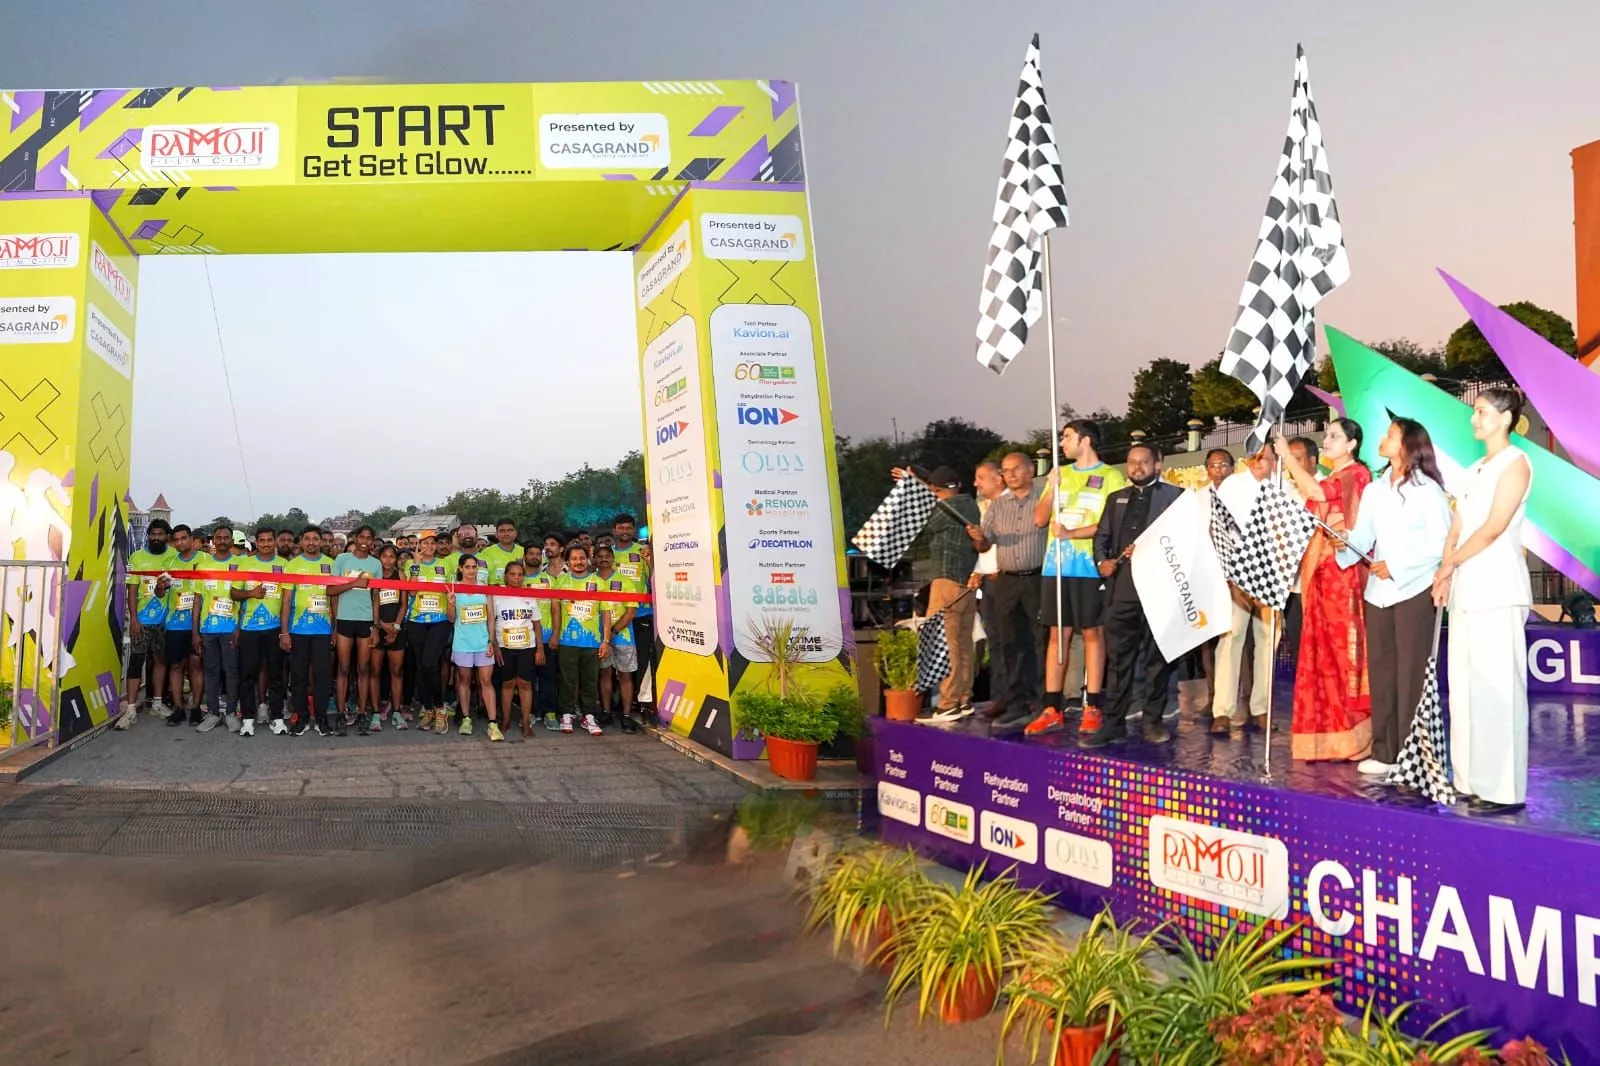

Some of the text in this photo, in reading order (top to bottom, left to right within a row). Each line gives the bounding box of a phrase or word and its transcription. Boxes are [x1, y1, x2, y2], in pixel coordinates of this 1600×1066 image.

[327, 104, 505, 148] START
[549, 122, 635, 133] Presented by
[151, 128, 263, 156] RAMOJI
[549, 142, 649, 154] CASAGRAND
[303, 154, 352, 178] Get
[359, 153, 408, 177] Set
[709, 220, 777, 232] Presented by
[710, 238, 789, 249] CASAGRAND
[641, 252, 682, 298] CASAGRAND
[37, 304, 50, 315] by
[733, 327, 789, 338] Kavion.ai
[90, 330, 126, 365] CASAGRAND
[737, 407, 779, 425] ION
[656, 421, 678, 446] ION
[765, 499, 809, 508] RENOVA
[761, 539, 813, 549] DECATHLON
[1160, 535, 1198, 622] CASAGRAND
[676, 627, 705, 639] ANYTIME
[676, 634, 705, 646] FITNESS
[889, 749, 904, 763] Tech
[885, 763, 908, 779] Partner
[931, 760, 964, 779] Associate
[935, 776, 960, 793] Partner
[983, 771, 1029, 794] Rehydration
[991, 789, 1020, 808] Partner
[1047, 785, 1102, 814] Dermatology
[1058, 805, 1091, 826] Partner
[990, 825, 1013, 848] ION
[1163, 829, 1264, 889] RAMOJI
